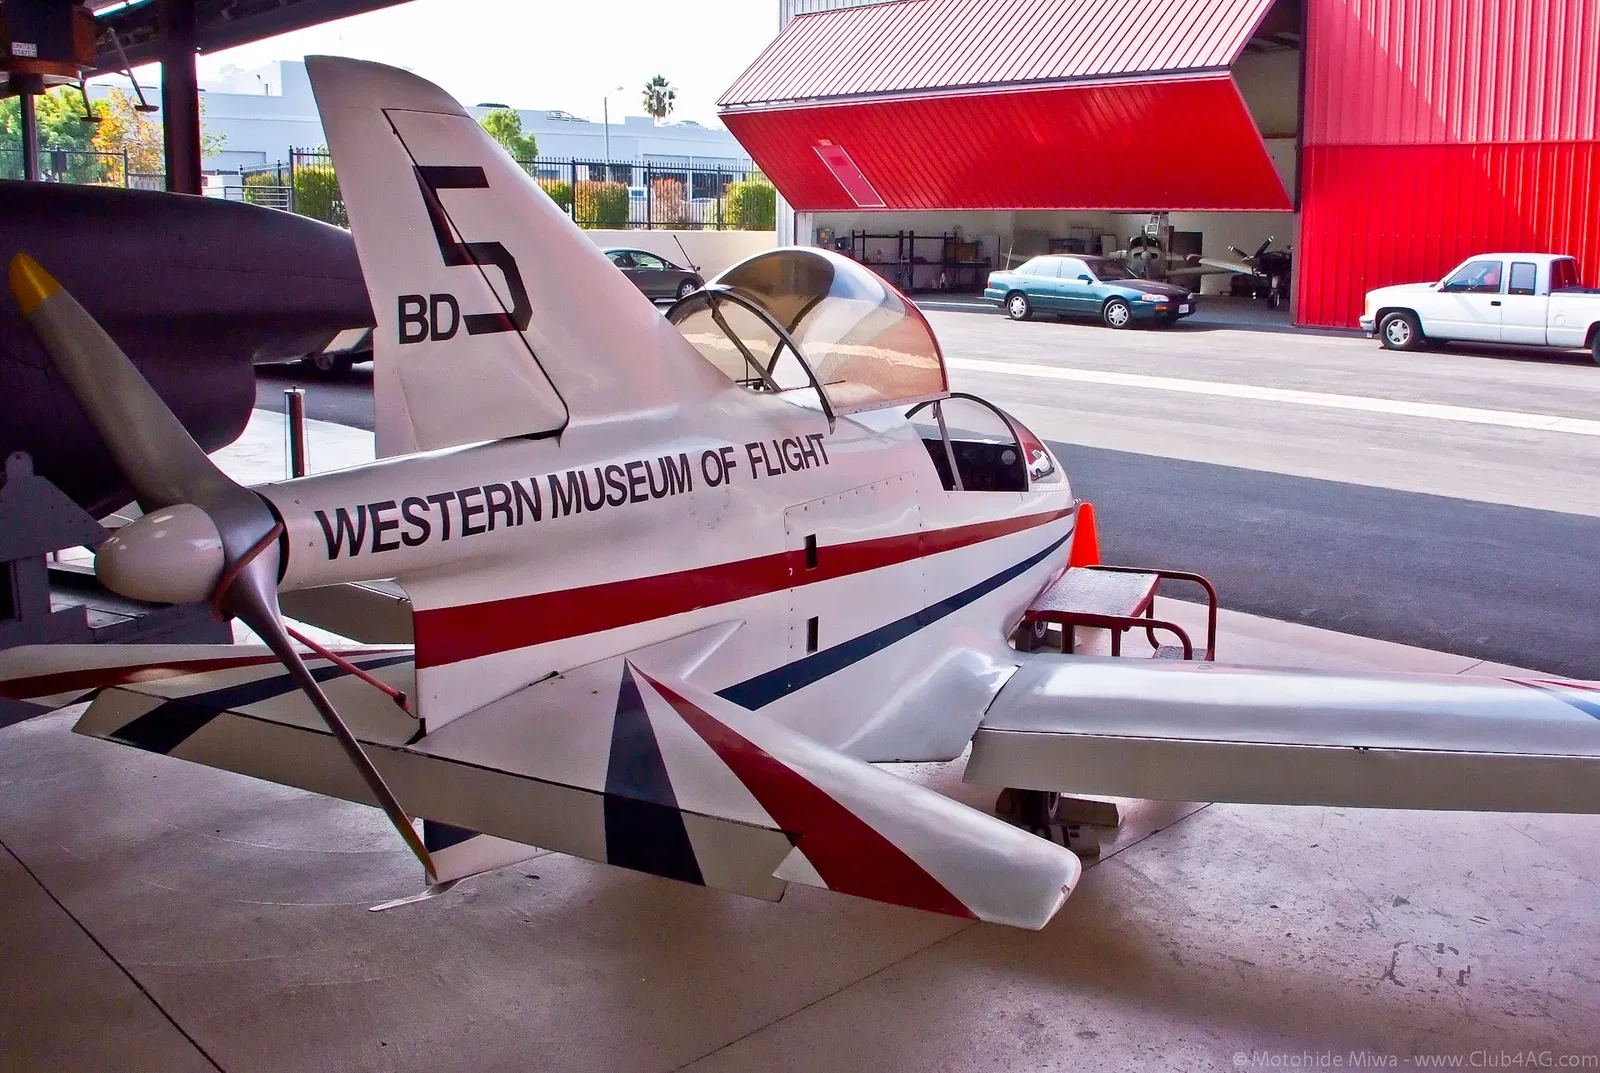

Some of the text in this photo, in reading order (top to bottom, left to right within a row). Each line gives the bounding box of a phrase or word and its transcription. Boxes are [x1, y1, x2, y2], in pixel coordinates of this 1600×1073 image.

[315, 433, 832, 560] WESTERN MUSEUM OF FLIGHT
